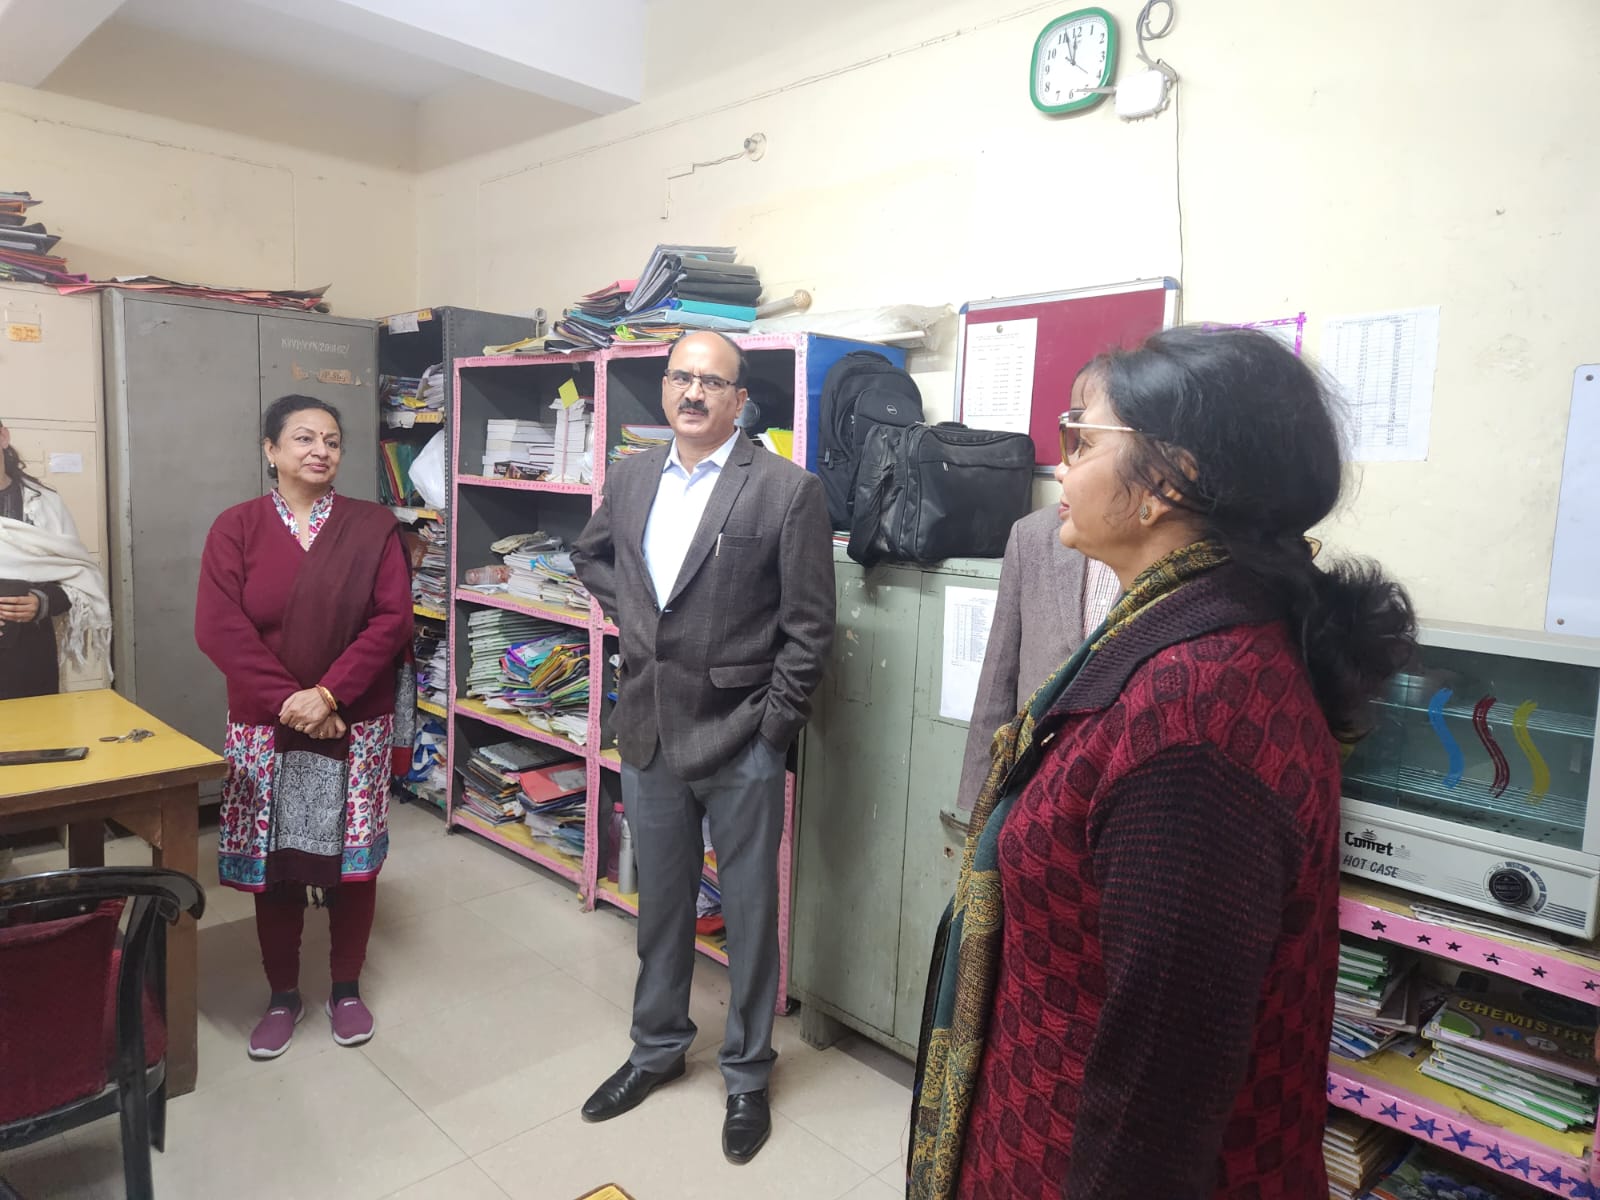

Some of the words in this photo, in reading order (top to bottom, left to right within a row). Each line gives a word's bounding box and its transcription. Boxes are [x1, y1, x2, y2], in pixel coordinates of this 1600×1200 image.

[1072, 26, 1082, 38] 12
[1090, 24, 1094, 35] 1
[1058, 32, 1068, 45] 11
[1099, 33, 1105, 44] 2
[1047, 48, 1056, 60] 10
[1099, 50, 1105, 63] 3
[1045, 65, 1050, 75] 9
[1096, 69, 1102, 80] 4
[1045, 82, 1051, 92] 8
[1056, 90, 1061, 101] 7
[1069, 89, 1074, 99] 6
[1344, 831, 1394, 856] Comet
[1343, 855, 1368, 870] HOT
[1370, 861, 1399, 878] CASE
[1457, 999, 1594, 1045] CHEMISTRY
